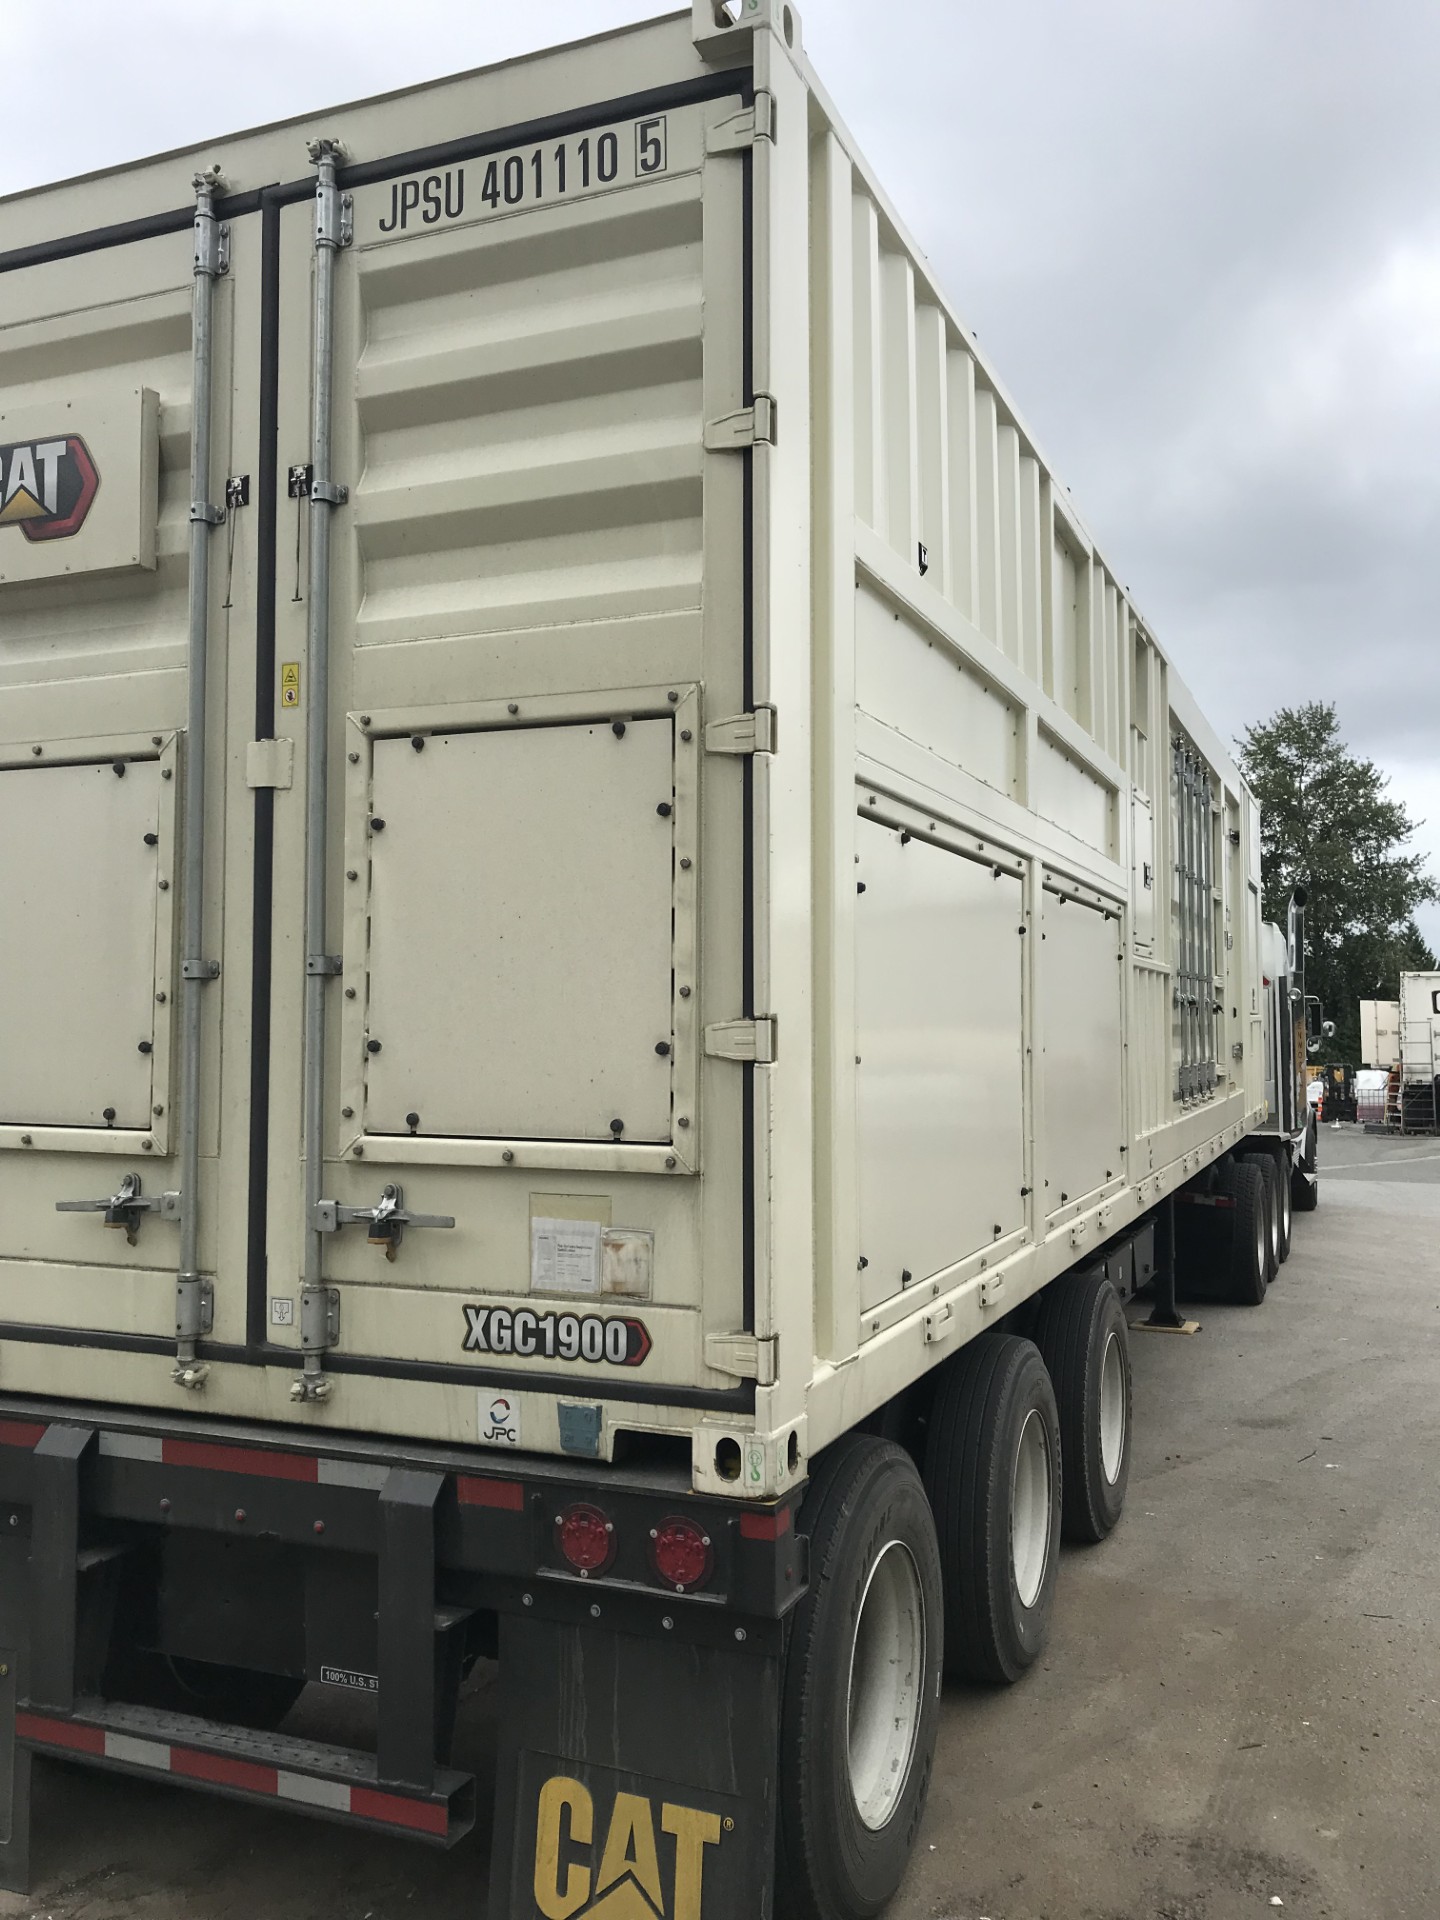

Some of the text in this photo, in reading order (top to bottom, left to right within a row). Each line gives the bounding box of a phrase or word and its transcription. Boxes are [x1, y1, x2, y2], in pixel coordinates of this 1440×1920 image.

[379, 119, 662, 232] JPSU 401110 5
[0, 440, 67, 514] AT
[466, 1308, 628, 1362] XGC1900
[483, 1426, 516, 1442] JPC
[325, 1671, 348, 1684] 100%
[349, 1675, 367, 1687] U.S.
